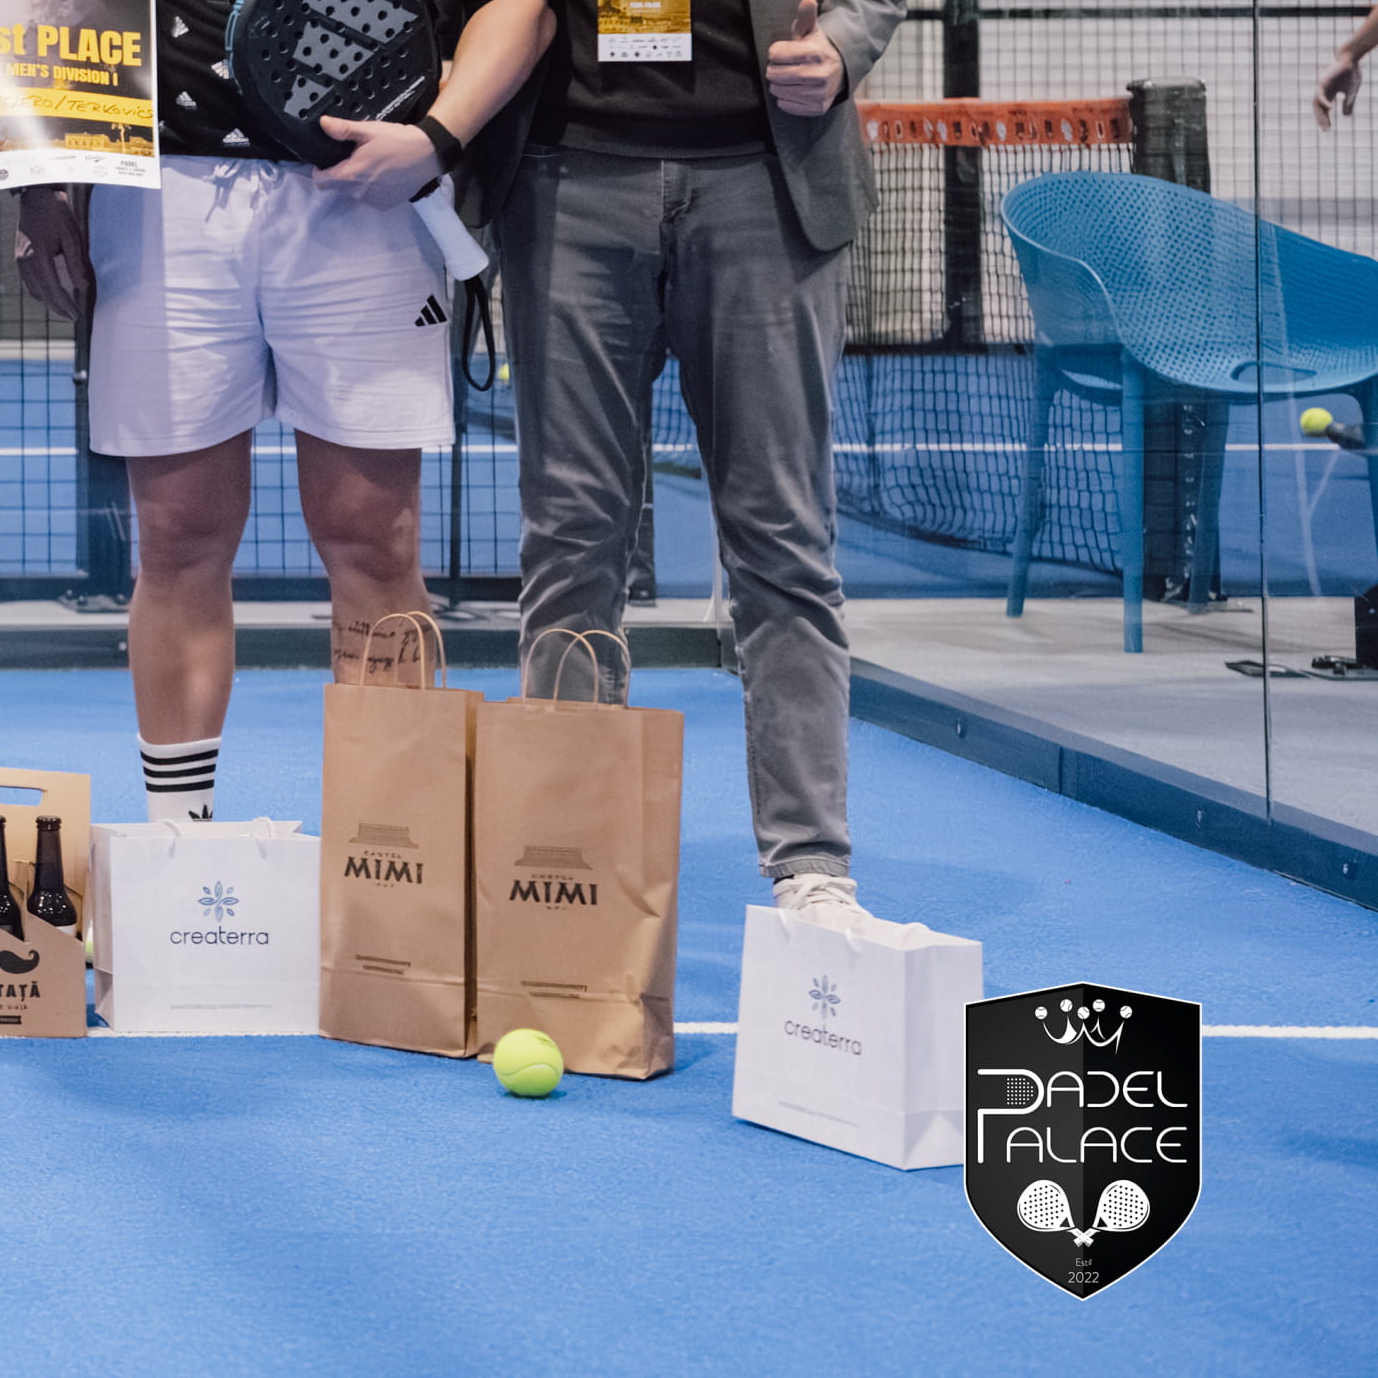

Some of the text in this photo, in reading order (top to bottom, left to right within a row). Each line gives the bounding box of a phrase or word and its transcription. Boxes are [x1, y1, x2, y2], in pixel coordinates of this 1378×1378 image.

[37, 25, 142, 66] PLACE
[53, 66, 109, 86] DIVISION
[344, 856, 423, 884] MIMI
[509, 879, 598, 905] MIMI
[170, 925, 269, 946] createrra
[784, 1019, 862, 1056] createrra
